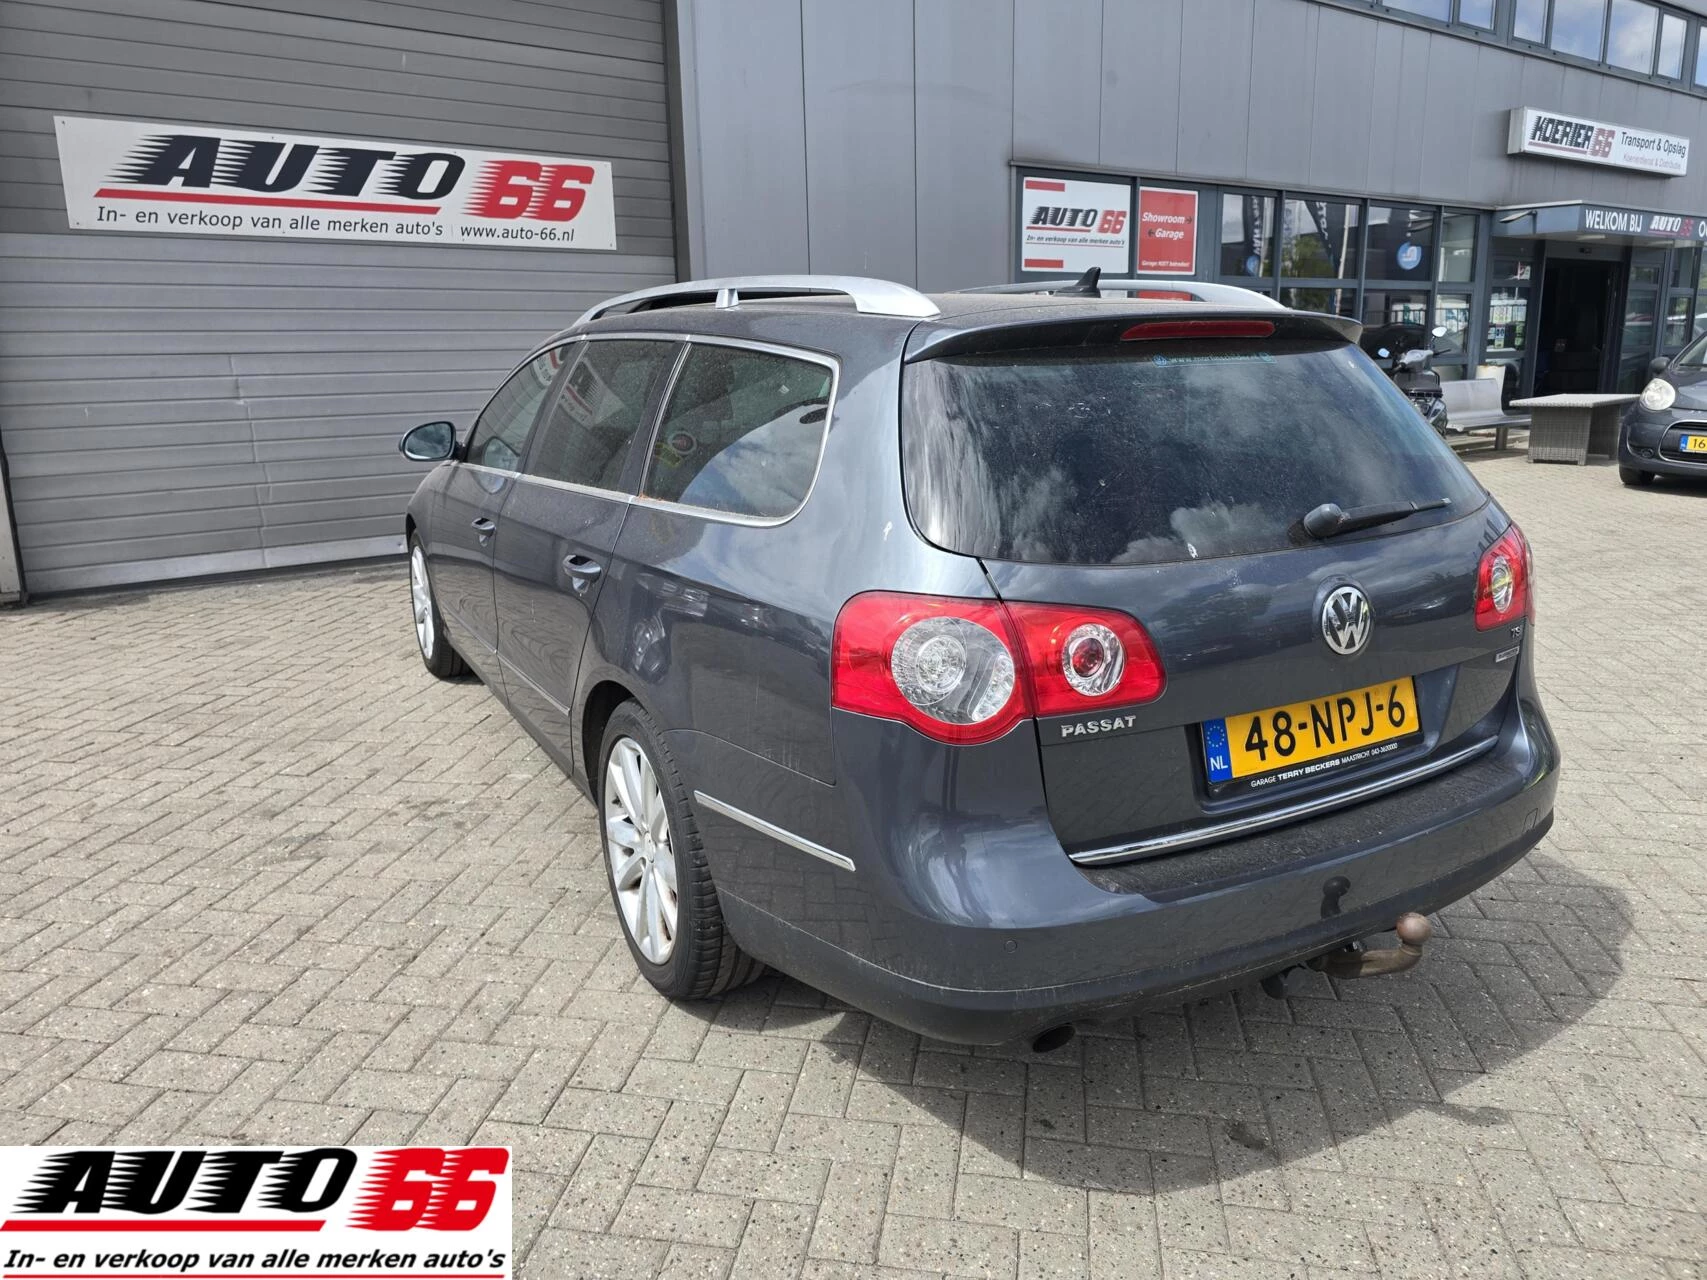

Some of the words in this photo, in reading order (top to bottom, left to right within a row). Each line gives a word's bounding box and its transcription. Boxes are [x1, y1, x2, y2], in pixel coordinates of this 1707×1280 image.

[1529, 115, 1595, 150] KOERIER
[1587, 127, 1616, 158] 66
[1621, 131, 1656, 151] Transport
[1656, 138, 1662, 151] &
[1663, 139, 1687, 159] Opslag
[104, 133, 467, 200] AUTO
[460, 159, 595, 222] 66
[97, 206, 127, 222] In-
[135, 209, 159, 224] en
[167, 210, 243, 231] verkoop
[251, 215, 282, 229] van
[289, 215, 321, 232] alle
[327, 218, 389, 234] merken
[395, 221, 443, 236] auto's
[460, 224, 575, 242] www.auto-66.nl
[1030, 205, 1098, 228] AUTO
[1096, 209, 1128, 234] 66
[1142, 211, 1186, 224] Showroom
[1585, 209, 1628, 231] WELKOM
[1629, 214, 1643, 233] BIJ
[1649, 215, 1681, 233] AUTO
[1155, 228, 1185, 240] Garage
[1060, 715, 1136, 737] PASSAT
[1244, 685, 1406, 761] 48-NPJ-6
[1210, 755, 1229, 771] NL
[1250, 775, 1277, 788] GARAGE
[1278, 768, 1306, 781] TERRY
[1305, 759, 1341, 774] BECKERS
[1341, 750, 1370, 764] MAASTRICHT
